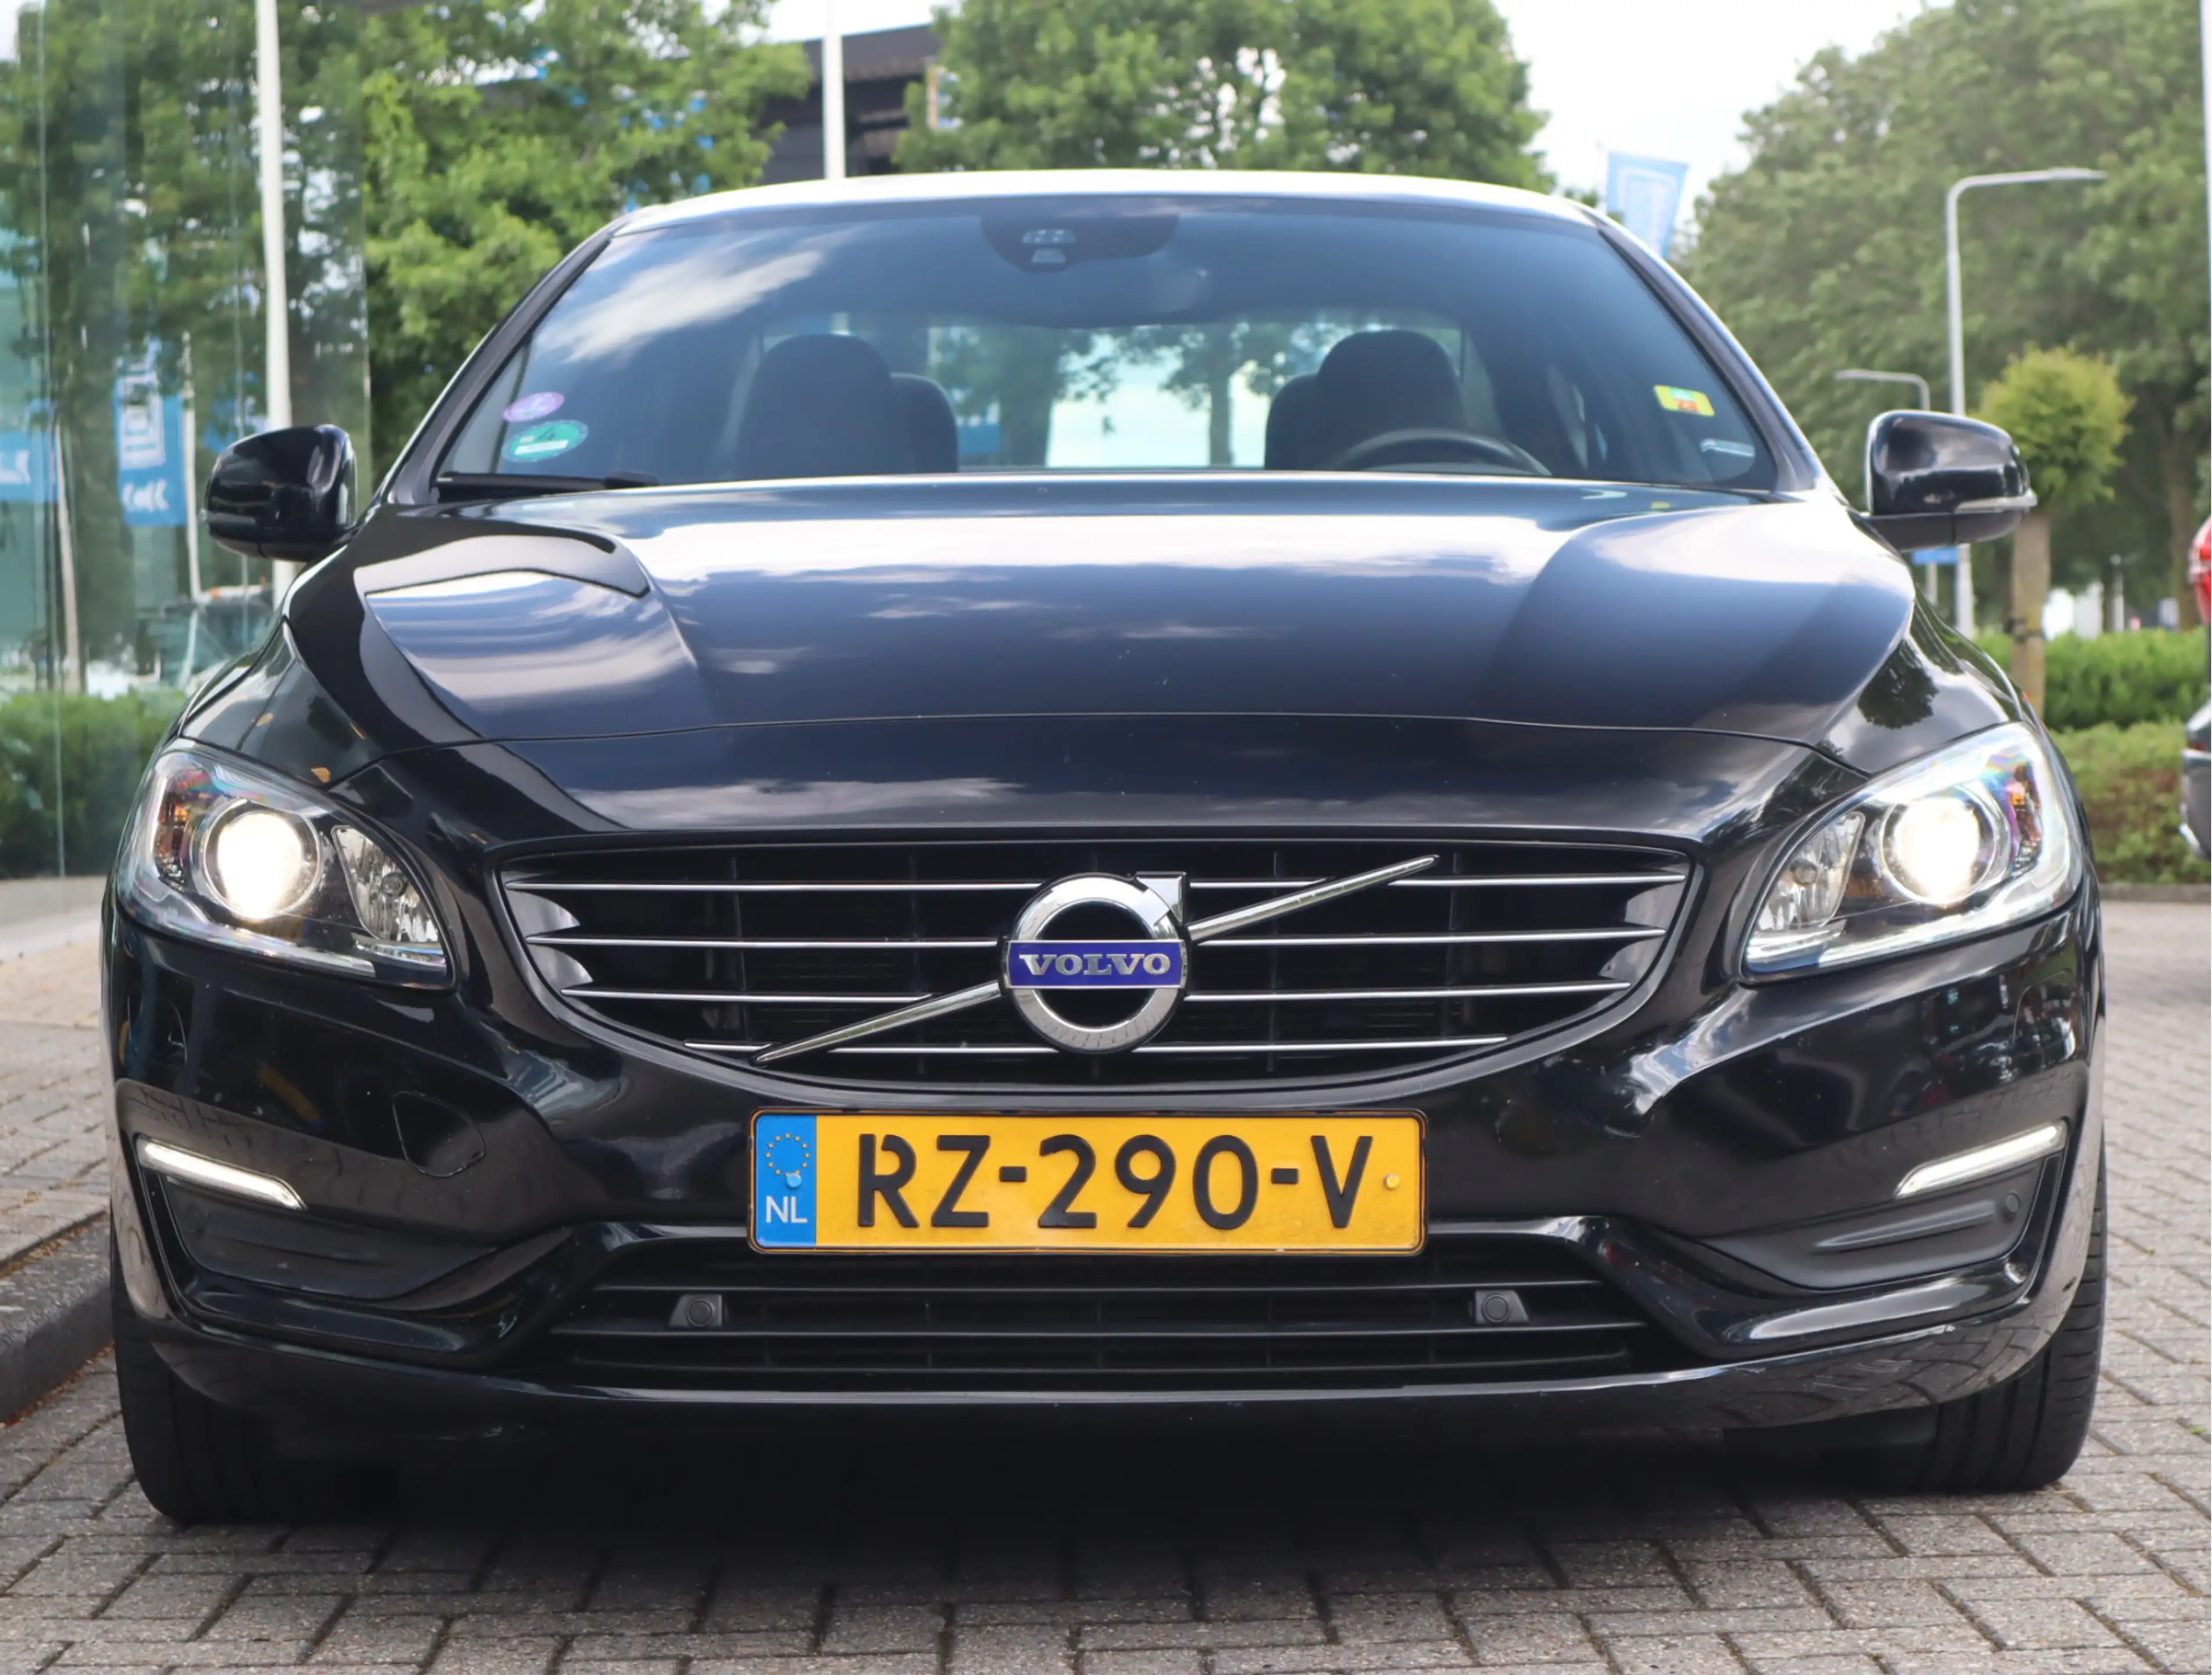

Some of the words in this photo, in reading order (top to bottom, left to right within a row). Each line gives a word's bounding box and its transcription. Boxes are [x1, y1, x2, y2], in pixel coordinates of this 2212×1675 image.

[1020, 954, 1171, 975] VOLVO
[857, 1134, 1373, 1229] RZ-290-V
[765, 1196, 807, 1224] NL
